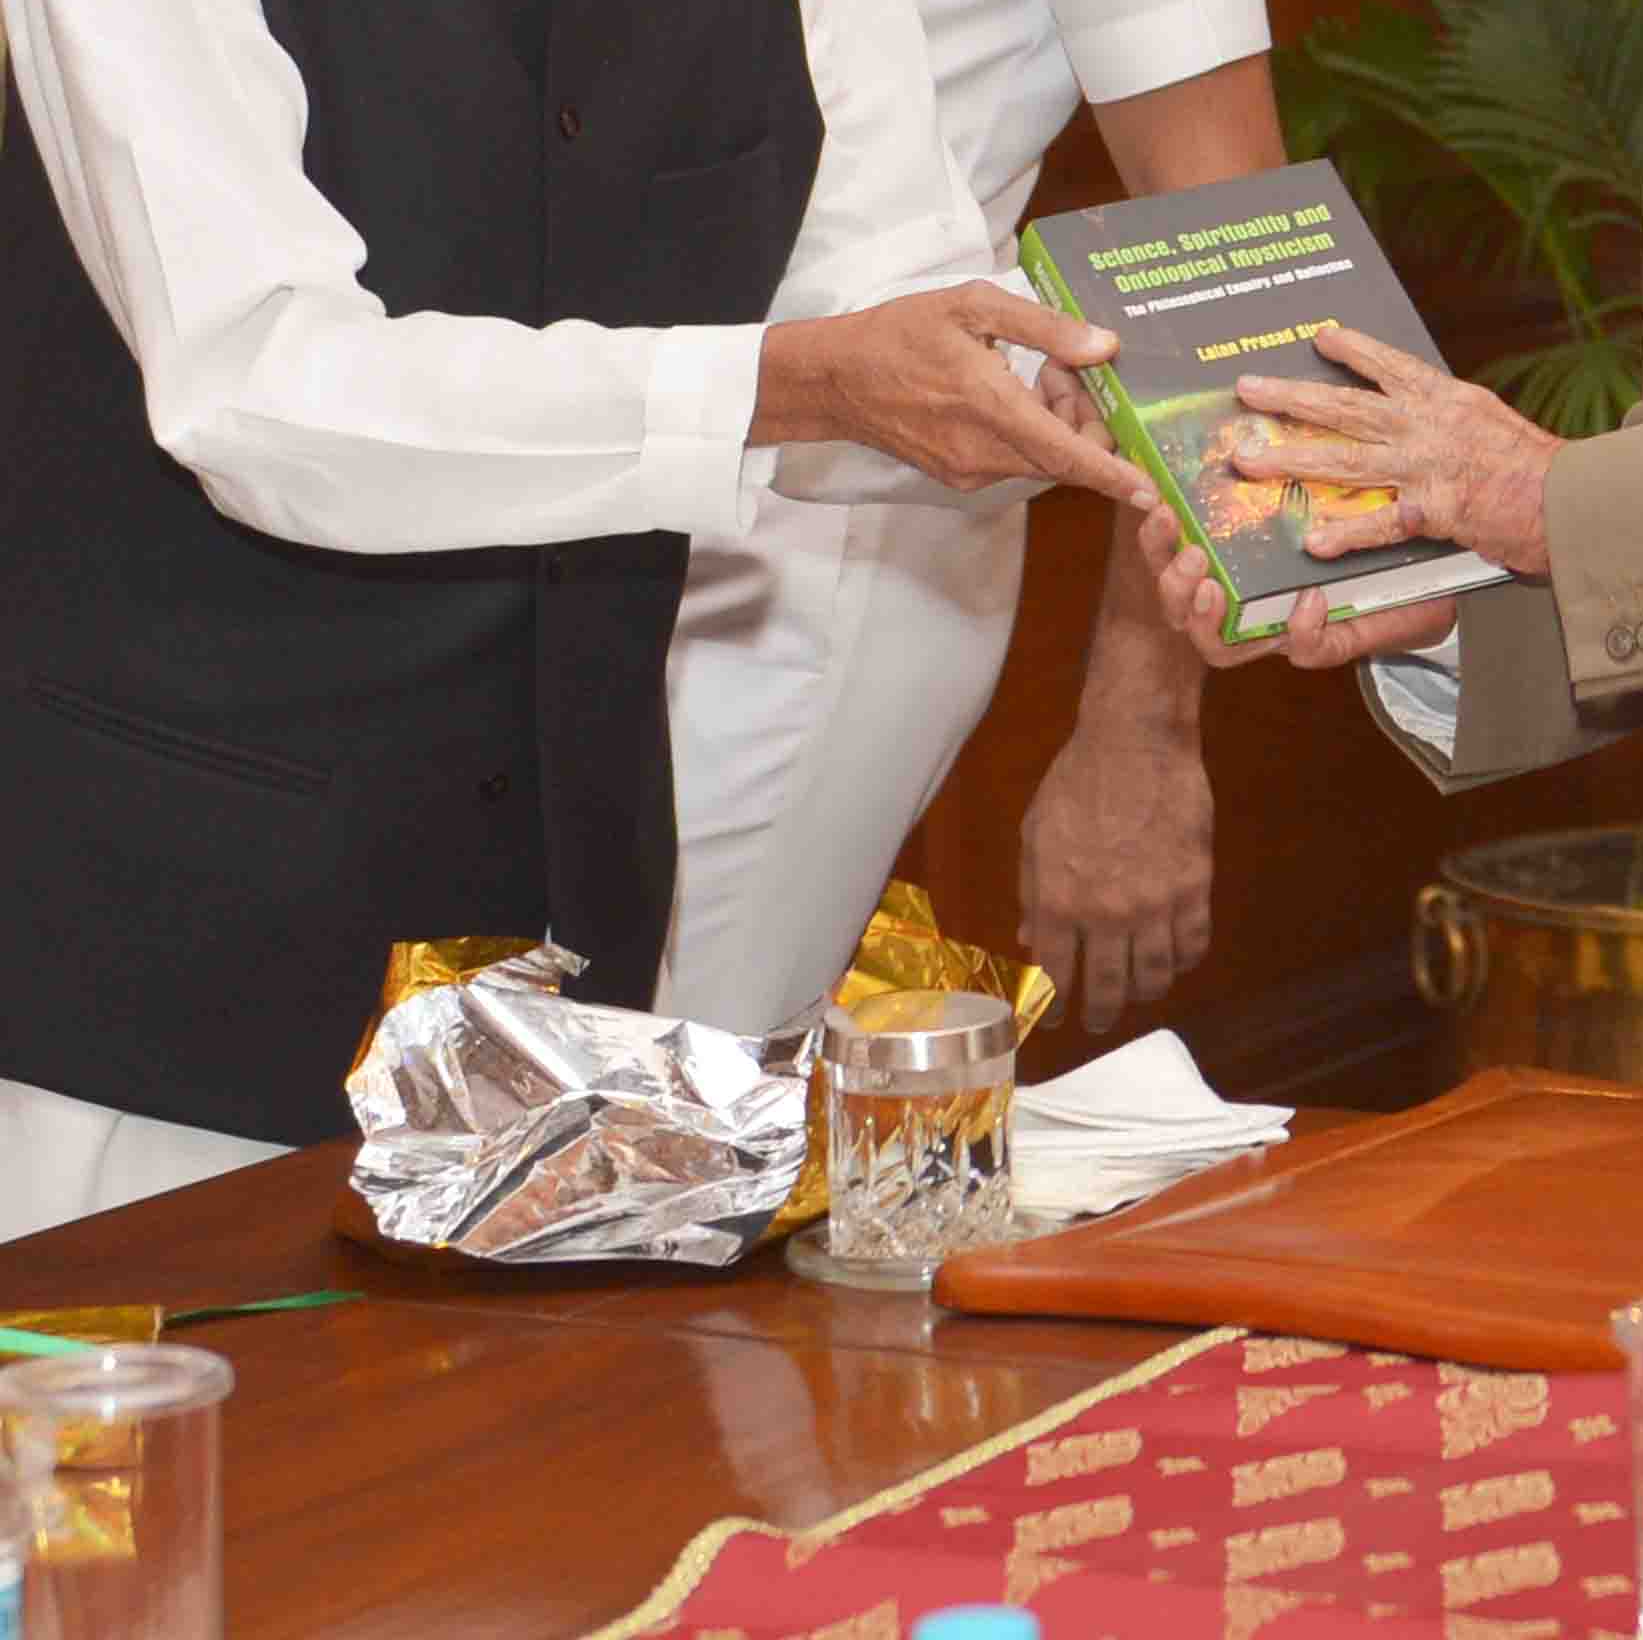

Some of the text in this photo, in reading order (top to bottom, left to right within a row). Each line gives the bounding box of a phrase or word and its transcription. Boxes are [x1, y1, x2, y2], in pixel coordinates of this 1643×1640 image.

[1176, 211, 1292, 252] Spirituality
[1293, 203, 1332, 228] and
[1113, 231, 1336, 294] Ontological Mysticism
